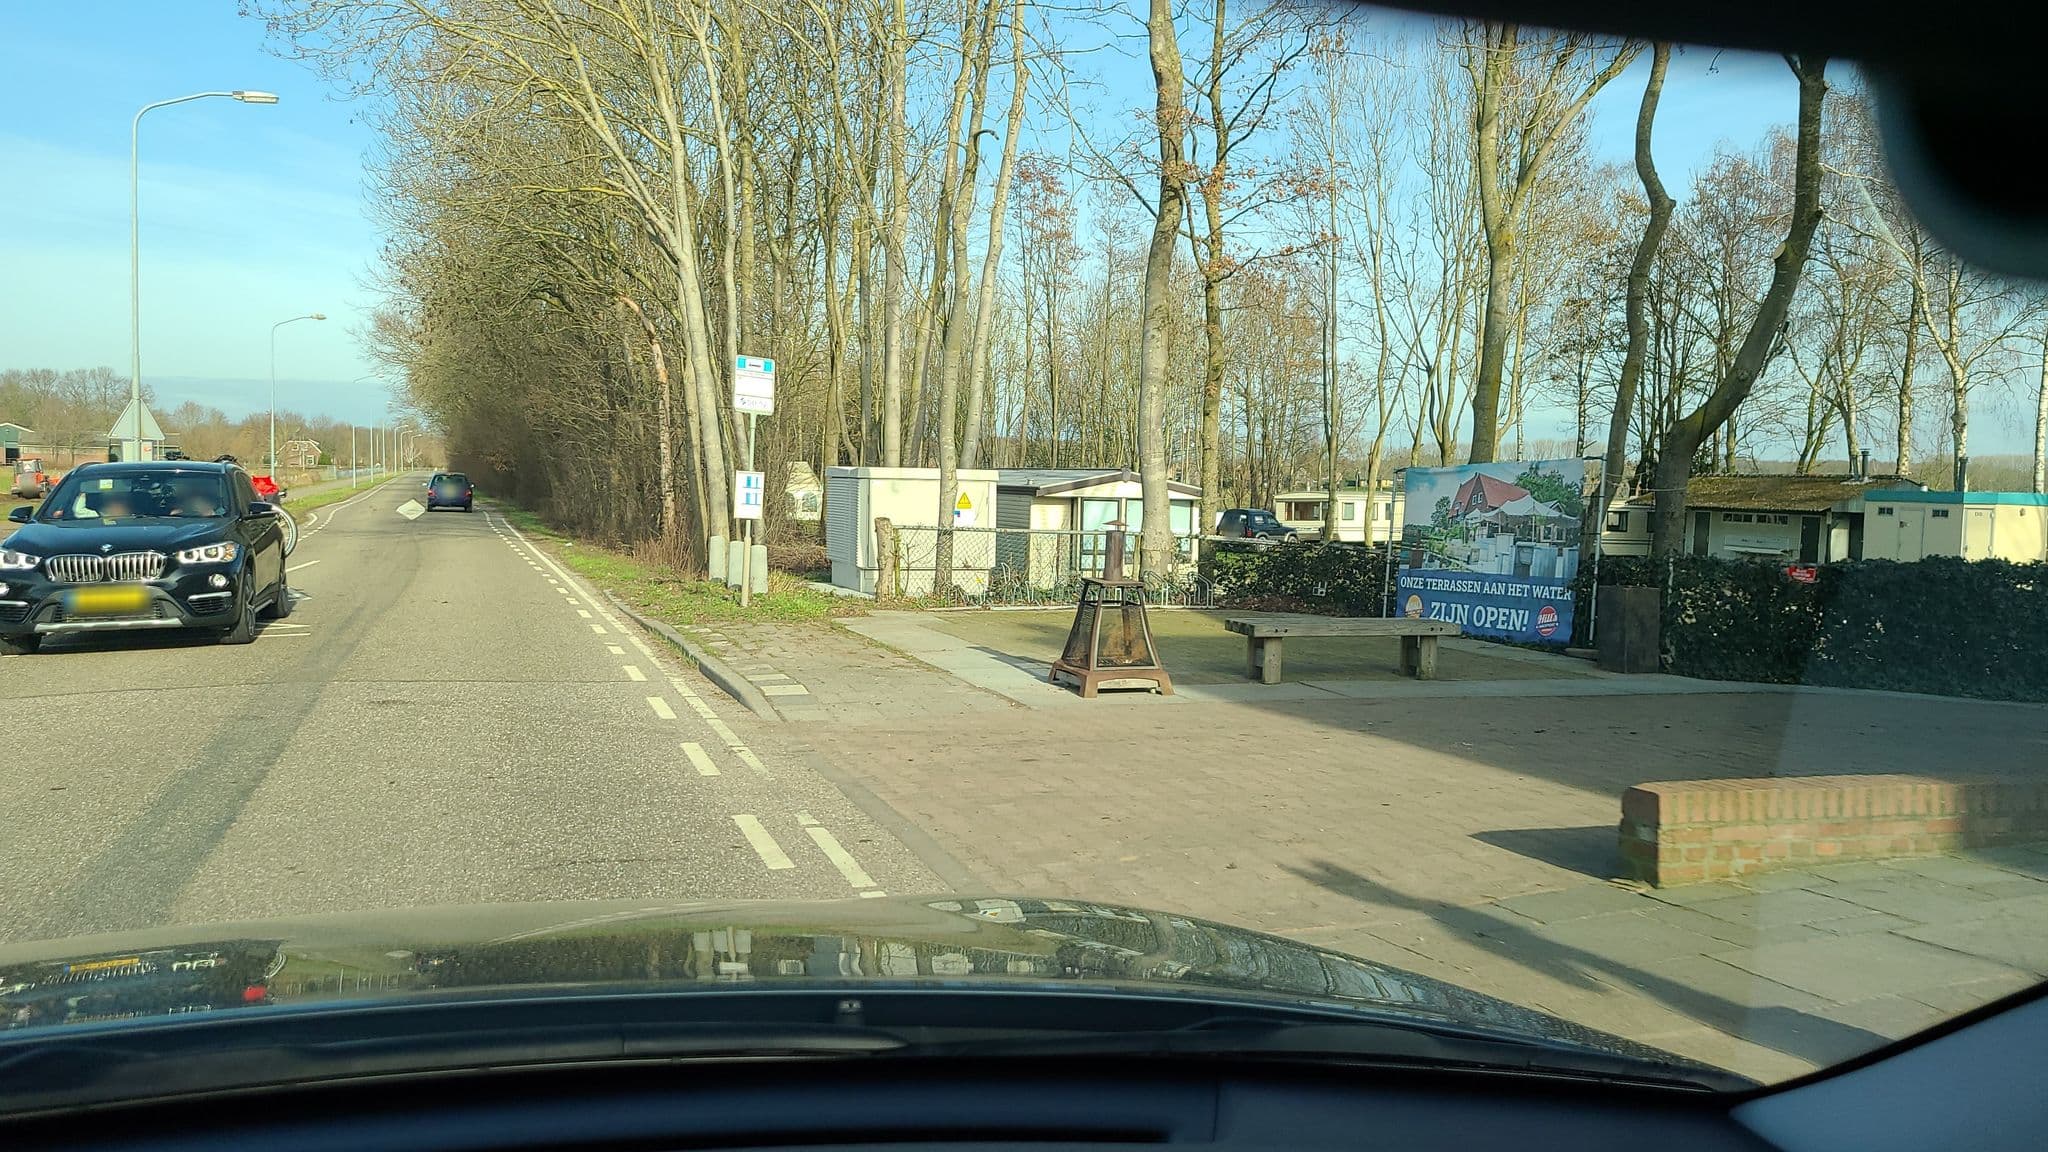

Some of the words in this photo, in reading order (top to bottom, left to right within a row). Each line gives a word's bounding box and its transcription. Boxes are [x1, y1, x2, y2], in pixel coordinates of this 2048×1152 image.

[1400, 576, 1424, 589] ONZE
[1426, 578, 1481, 593] TERRASSEN
[1483, 581, 1506, 595] AAN
[1507, 583, 1530, 597] HET
[1532, 585, 1571, 600] WATER
[1429, 601, 1470, 625] ZIJN
[1473, 605, 1529, 631] OPEN!
